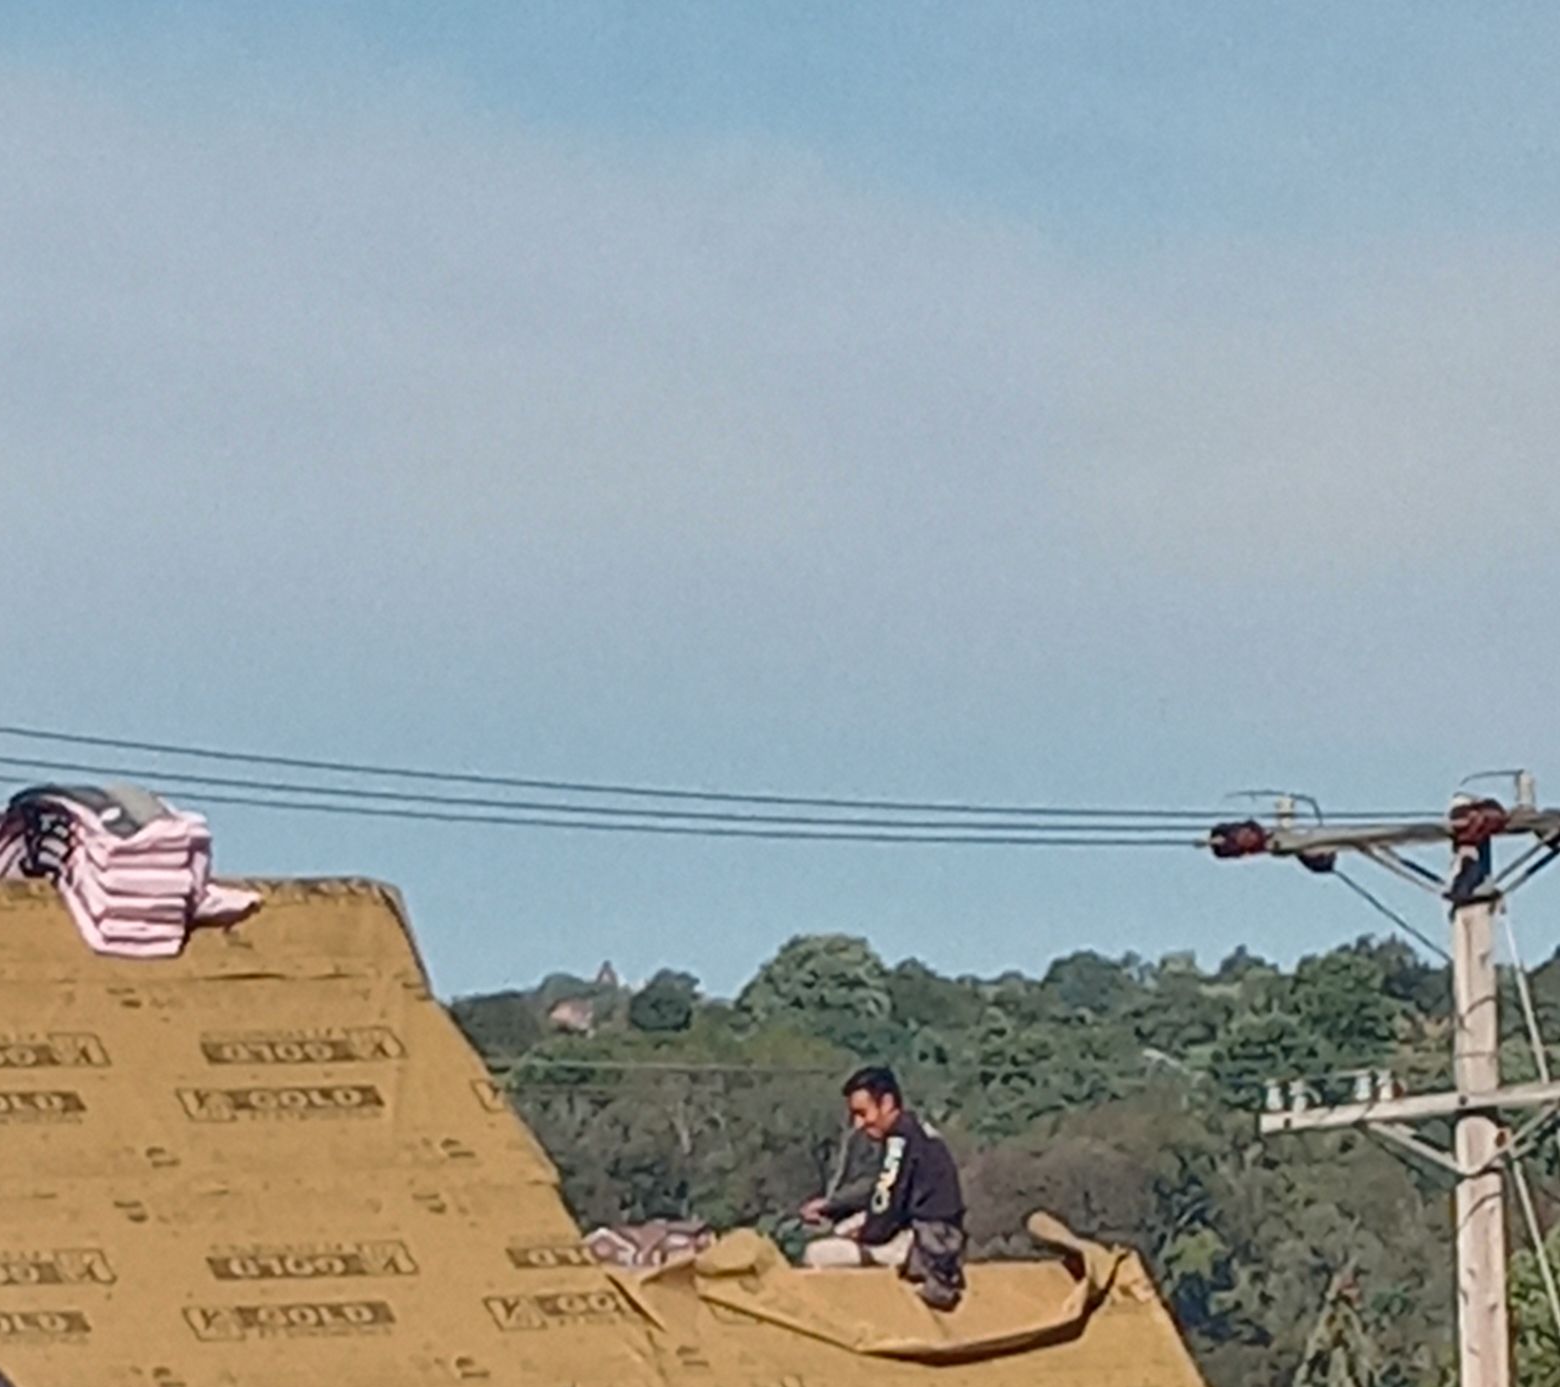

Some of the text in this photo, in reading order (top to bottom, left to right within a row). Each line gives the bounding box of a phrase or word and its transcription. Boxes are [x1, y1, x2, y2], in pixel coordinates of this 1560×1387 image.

[221, 1041, 335, 1063] GOLD
[248, 1087, 363, 1109] GOLD
[228, 1255, 346, 1279] GOLD
[256, 1303, 375, 1326] GOLD
